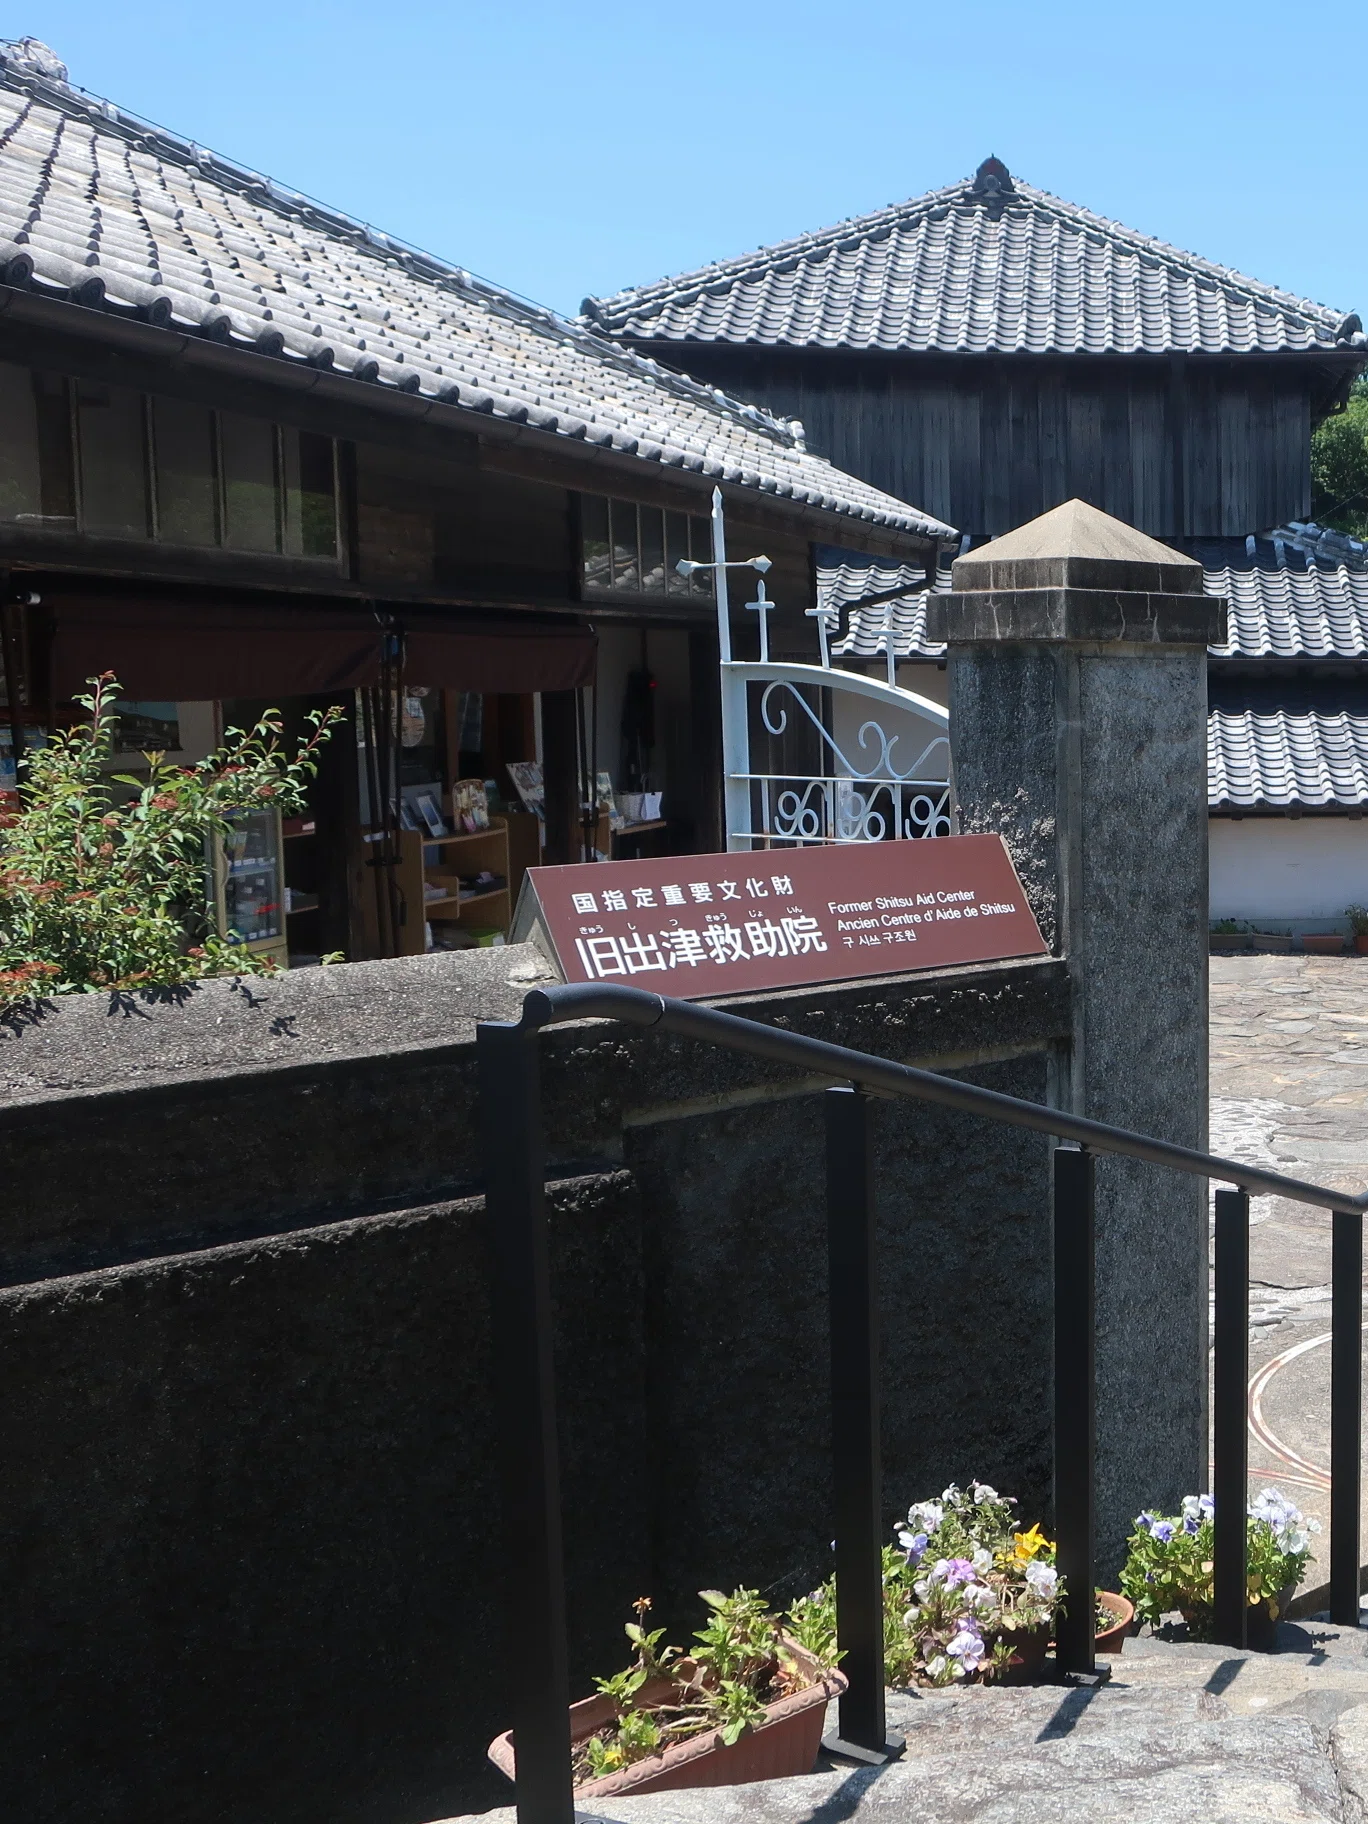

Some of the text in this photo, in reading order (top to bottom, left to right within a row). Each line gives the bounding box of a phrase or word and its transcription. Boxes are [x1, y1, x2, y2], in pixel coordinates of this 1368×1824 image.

[571, 875, 794, 914] 国指定重要文化財
[828, 889, 976, 915] Former Shitsu Aid Center
[579, 925, 604, 935] きゅう
[704, 912, 727, 922] きゅう
[748, 909, 764, 919] じょ
[786, 905, 803, 915] いん
[837, 916, 880, 932] Ancien
[881, 912, 922, 927] Centre
[963, 903, 979, 917] de
[979, 902, 1016, 917] Shitsu
[574, 915, 828, 979] 旧出津救助院
[842, 936, 854, 949] 구
[882, 929, 917, 944] 구조원
